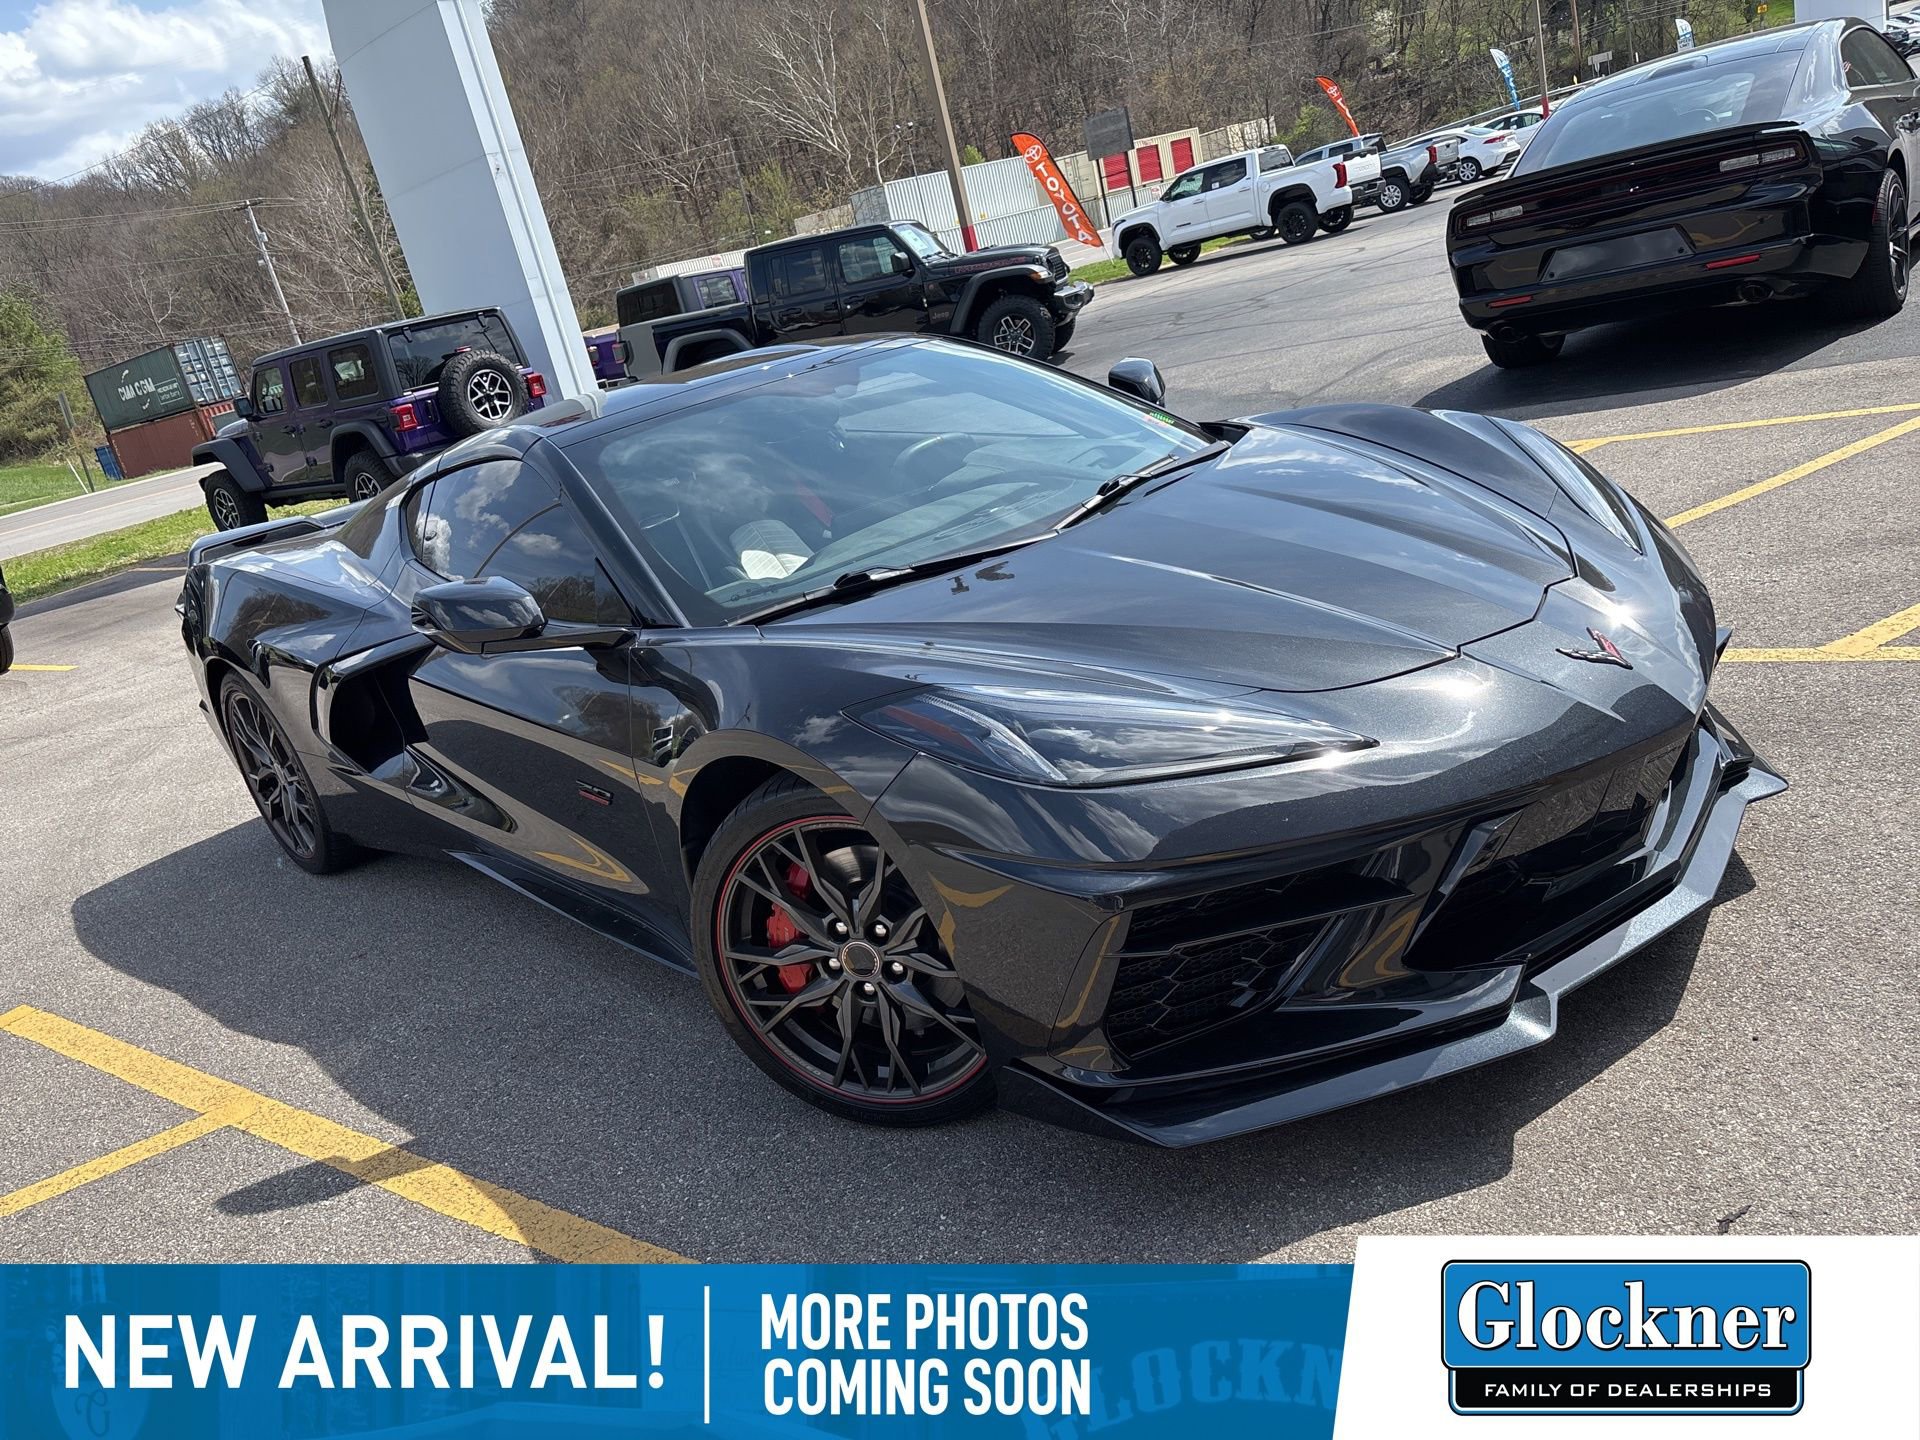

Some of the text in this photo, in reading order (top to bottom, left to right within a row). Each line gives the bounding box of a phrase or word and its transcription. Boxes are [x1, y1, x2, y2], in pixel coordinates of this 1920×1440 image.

[1036, 161, 1093, 241] TOYOTA
[932, 310, 949, 320] Jeep
[117, 381, 136, 401] CMA
[134, 377, 156, 396] CGM
